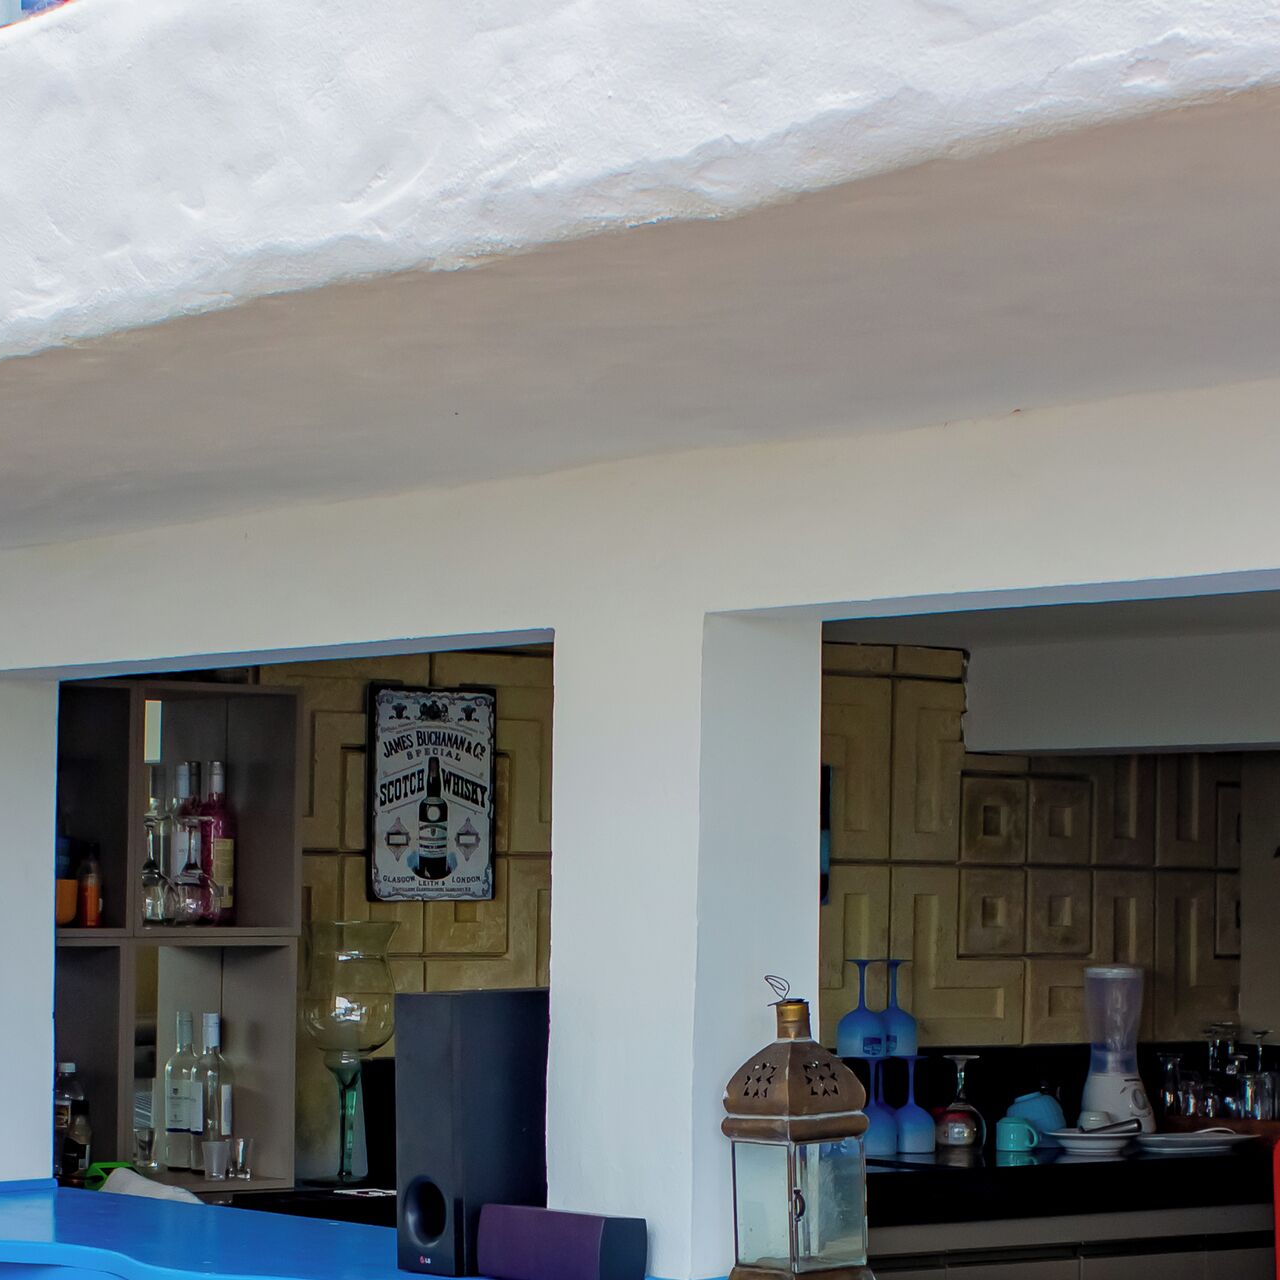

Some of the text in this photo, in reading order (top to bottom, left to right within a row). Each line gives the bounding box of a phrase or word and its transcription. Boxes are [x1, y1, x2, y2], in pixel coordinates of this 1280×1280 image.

[384, 733, 414, 758] JAMES
[416, 731, 466, 752] BUCHANAN
[406, 747, 461, 761] SPECIAL
[380, 768, 487, 808] SCOTCH WHISKY
[383, 875, 415, 883] GLASGOW
[452, 875, 480, 883] LONDON
